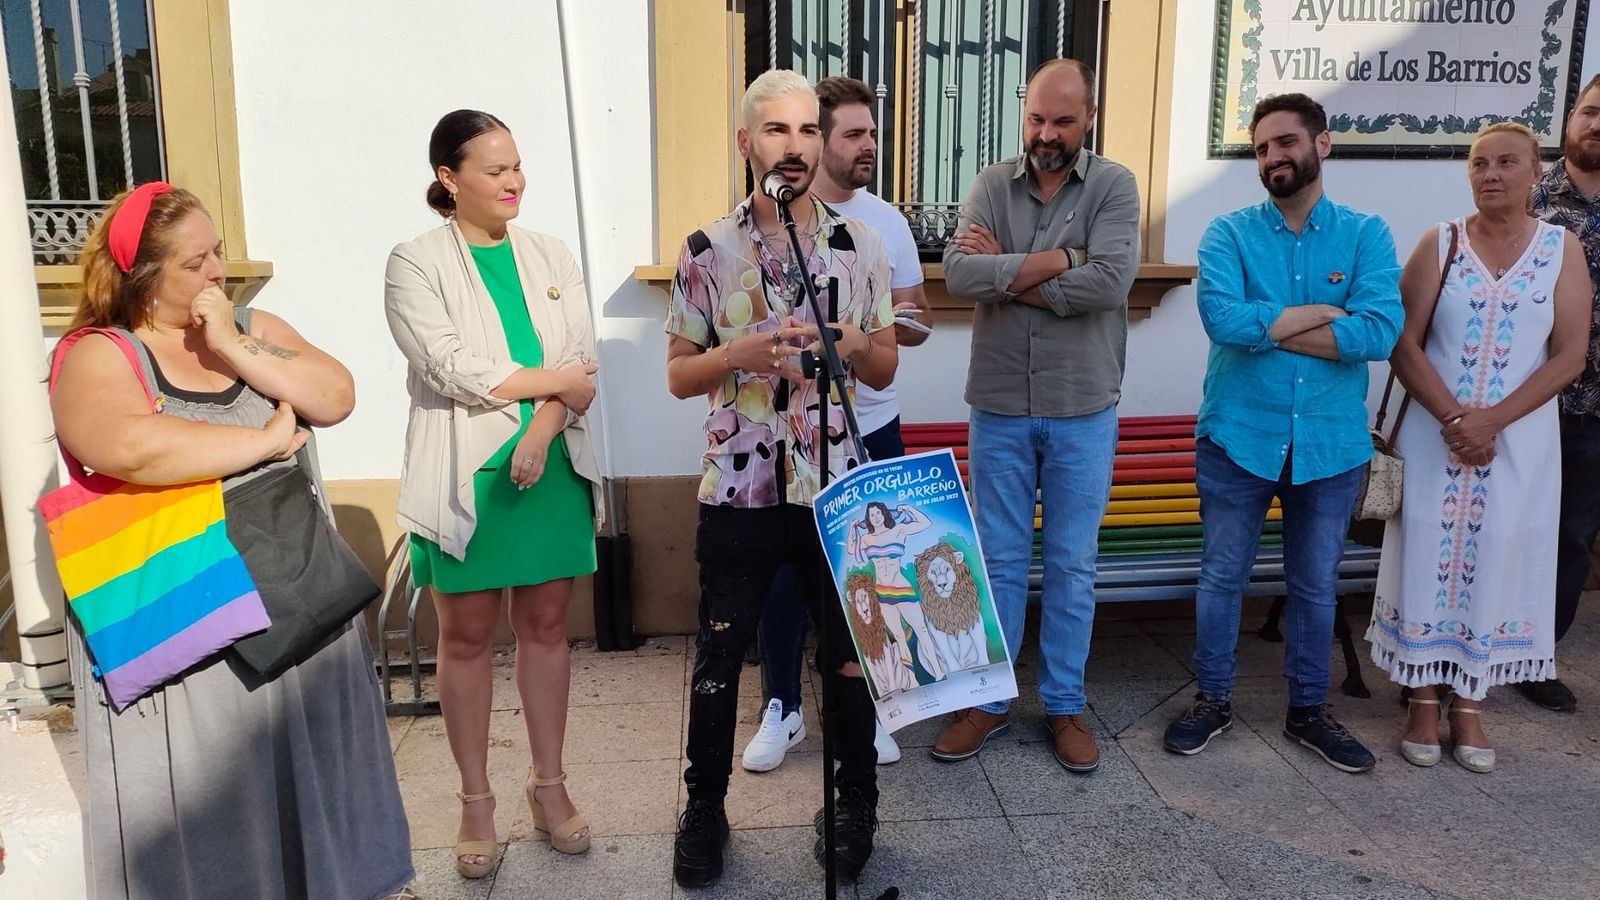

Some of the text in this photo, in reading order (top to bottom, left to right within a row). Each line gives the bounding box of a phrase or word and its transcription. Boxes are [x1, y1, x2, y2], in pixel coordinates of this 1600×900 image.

[1292, 0, 1515, 31] Ayuntamiento
[1269, 47, 1531, 84] Villa de Los Barrios
[823, 486, 862, 518] PRIMER
[864, 466, 941, 494] ORGULLO
[898, 479, 957, 501] BARREÑO
